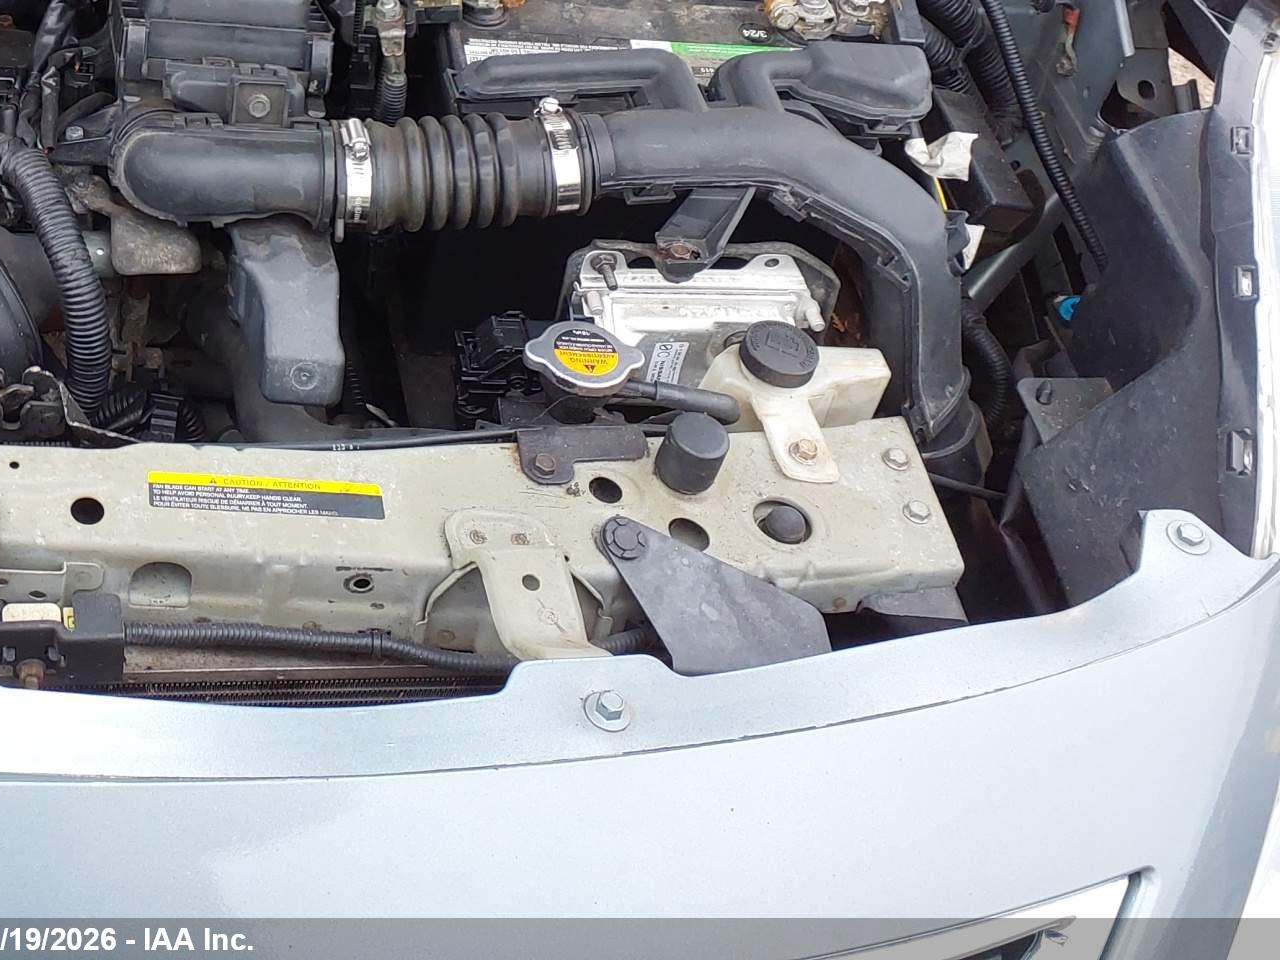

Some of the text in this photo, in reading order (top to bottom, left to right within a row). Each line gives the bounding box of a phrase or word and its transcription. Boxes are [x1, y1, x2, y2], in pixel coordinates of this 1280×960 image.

[742, 29, 768, 38] 3/24
[223, 478, 263, 487] CAUTION
[272, 481, 321, 490] ATTENTION
